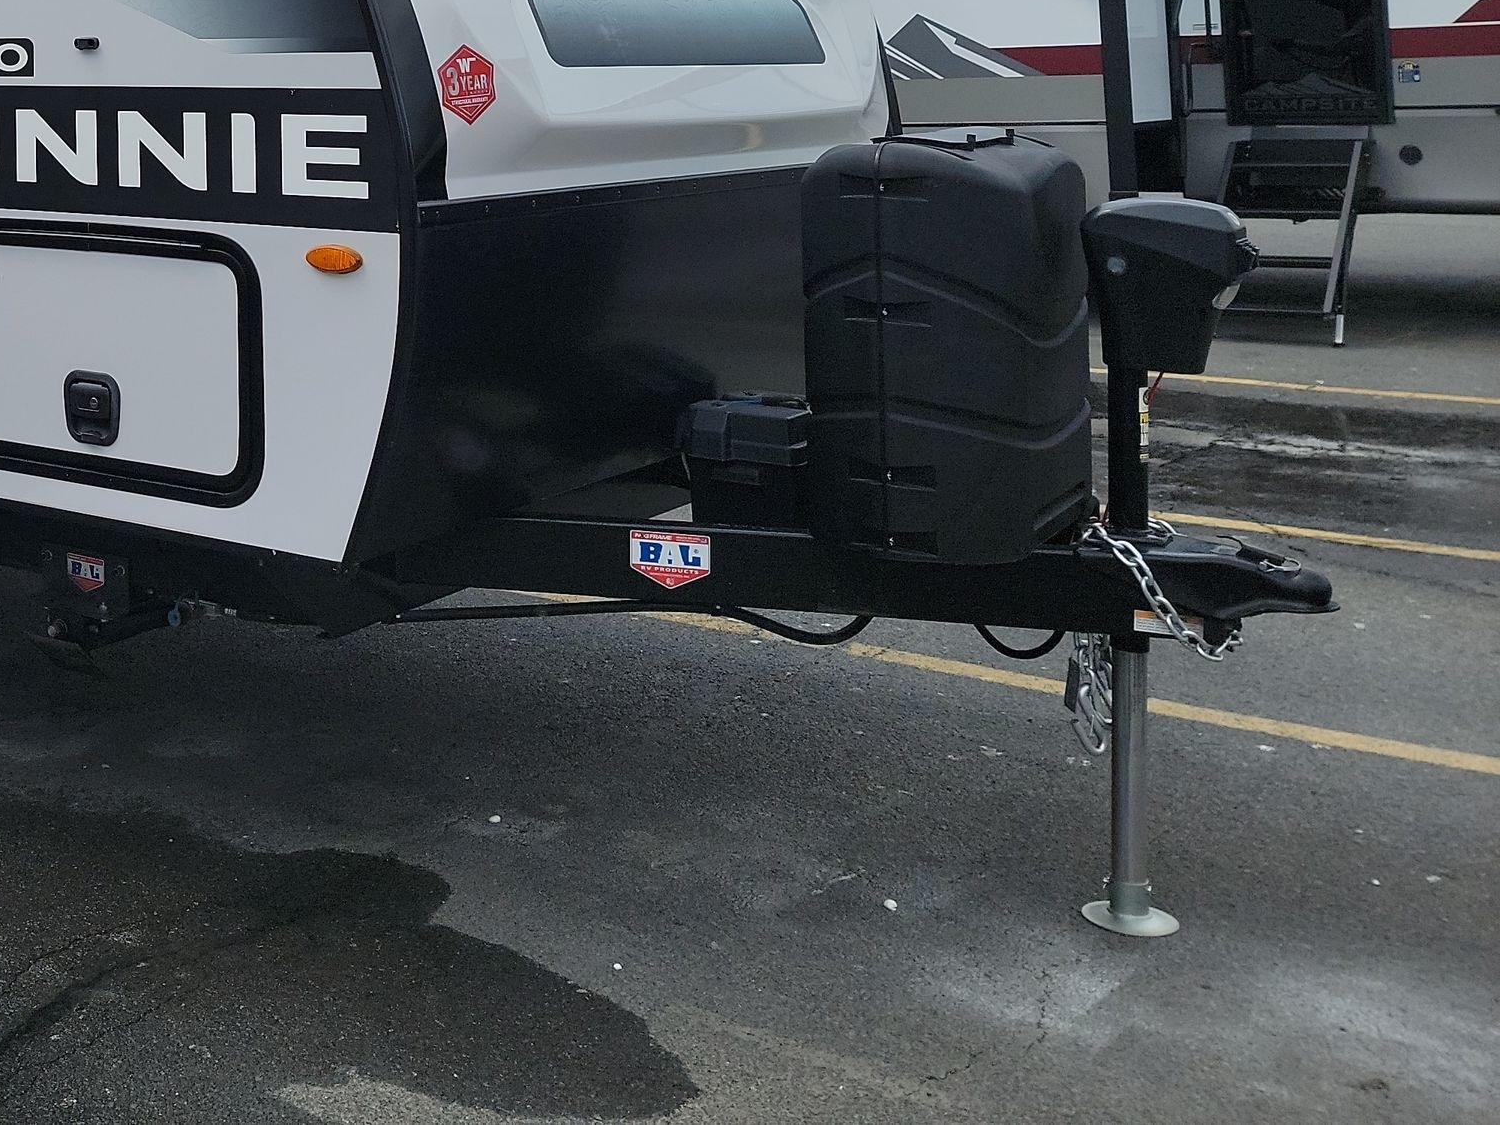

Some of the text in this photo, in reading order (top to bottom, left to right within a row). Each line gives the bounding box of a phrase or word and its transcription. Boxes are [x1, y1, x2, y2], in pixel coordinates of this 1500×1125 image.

[446, 66, 488, 96] 3 YEAR
[639, 541, 701, 567] BAL
